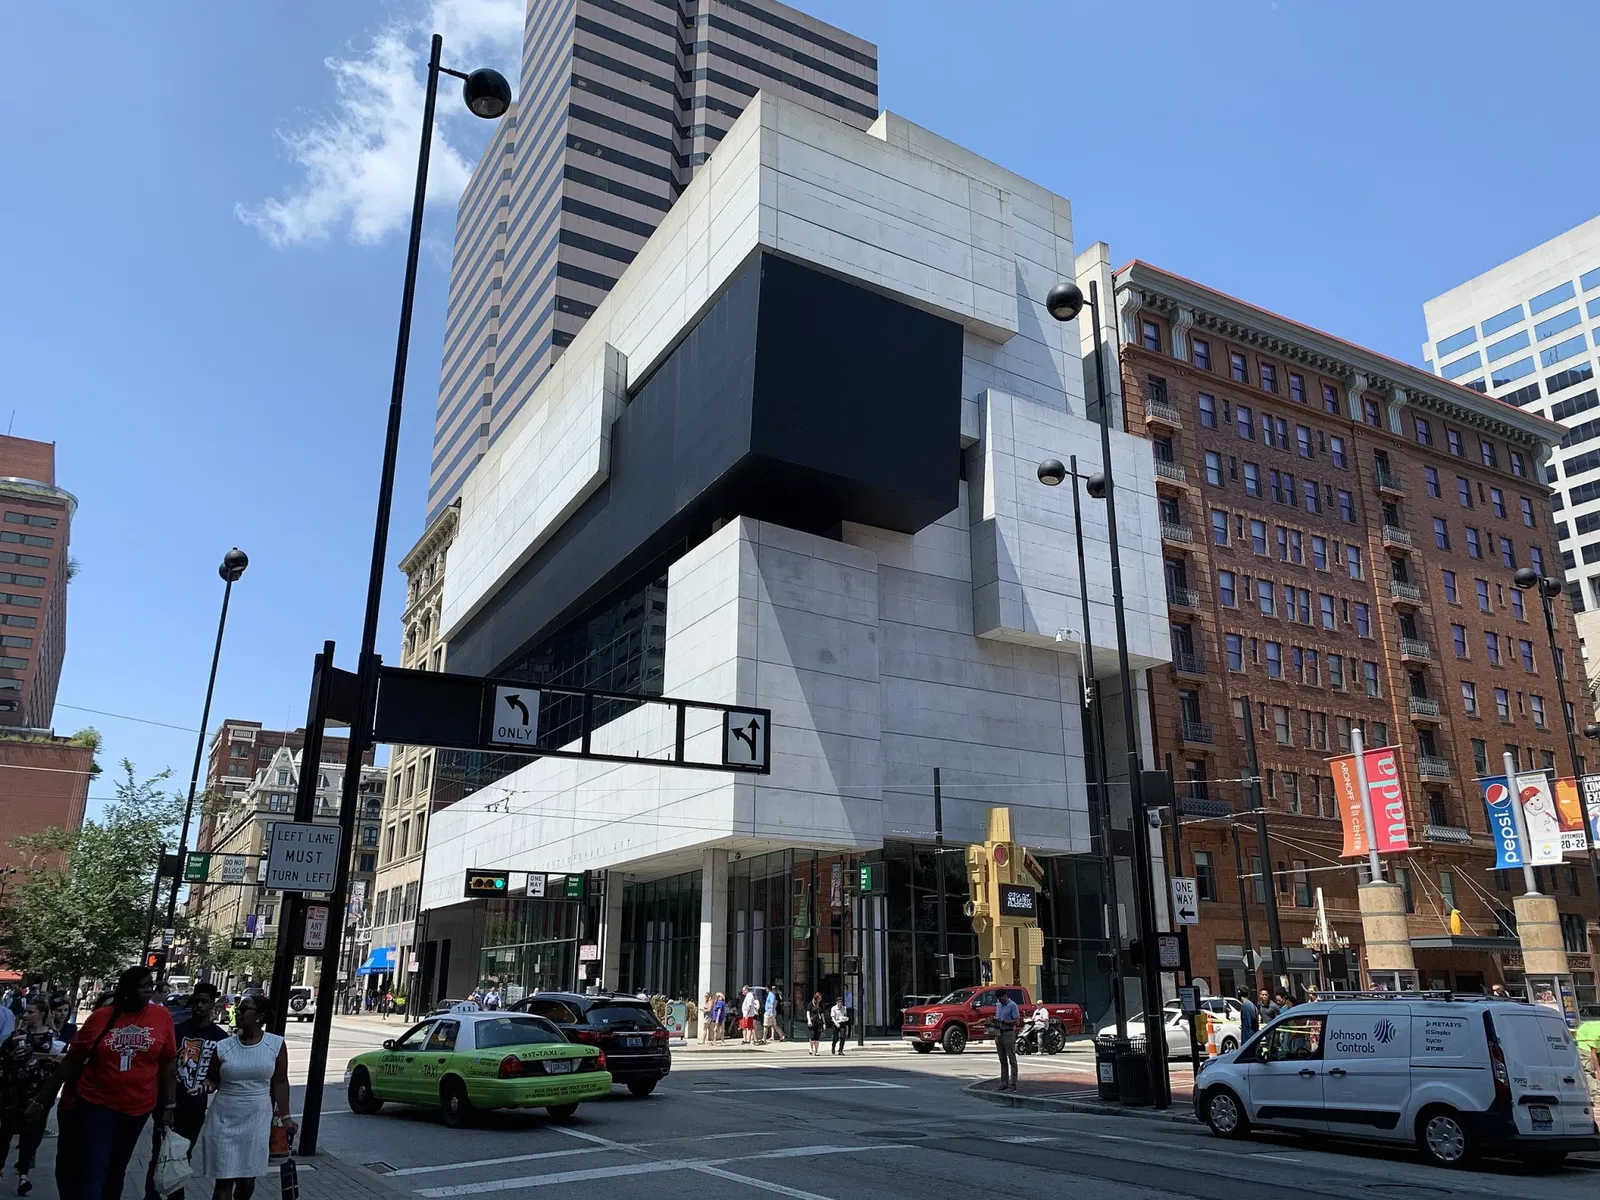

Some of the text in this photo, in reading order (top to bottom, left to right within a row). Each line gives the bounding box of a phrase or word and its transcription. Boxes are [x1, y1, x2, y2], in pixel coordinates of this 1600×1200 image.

[498, 726, 533, 740] ONLY
[1340, 761, 1355, 801] ARONOFF
[1586, 792, 1600, 804] EX
[277, 830, 335, 845] LEFT LANE
[1351, 817, 1362, 850] CENTER
[1494, 811, 1520, 863] pepsi
[1561, 839, 1571, 849] 20
[1575, 839, 1585, 848] 22
[284, 849, 323, 864] MUST
[233, 859, 245, 867] NOT
[224, 867, 244, 875] BLOCK
[272, 869, 300, 882] TURN
[305, 871, 331, 884] LEFT
[1175, 881, 1193, 893] ONE
[1176, 893, 1194, 905] WAY
[310, 922, 323, 930] ANY
[309, 931, 321, 940] TIME
[1329, 1029, 1367, 1041] Johnson
[1336, 1041, 1376, 1054] Controls
[521, 1050, 558, 1059] 917-TAXI
